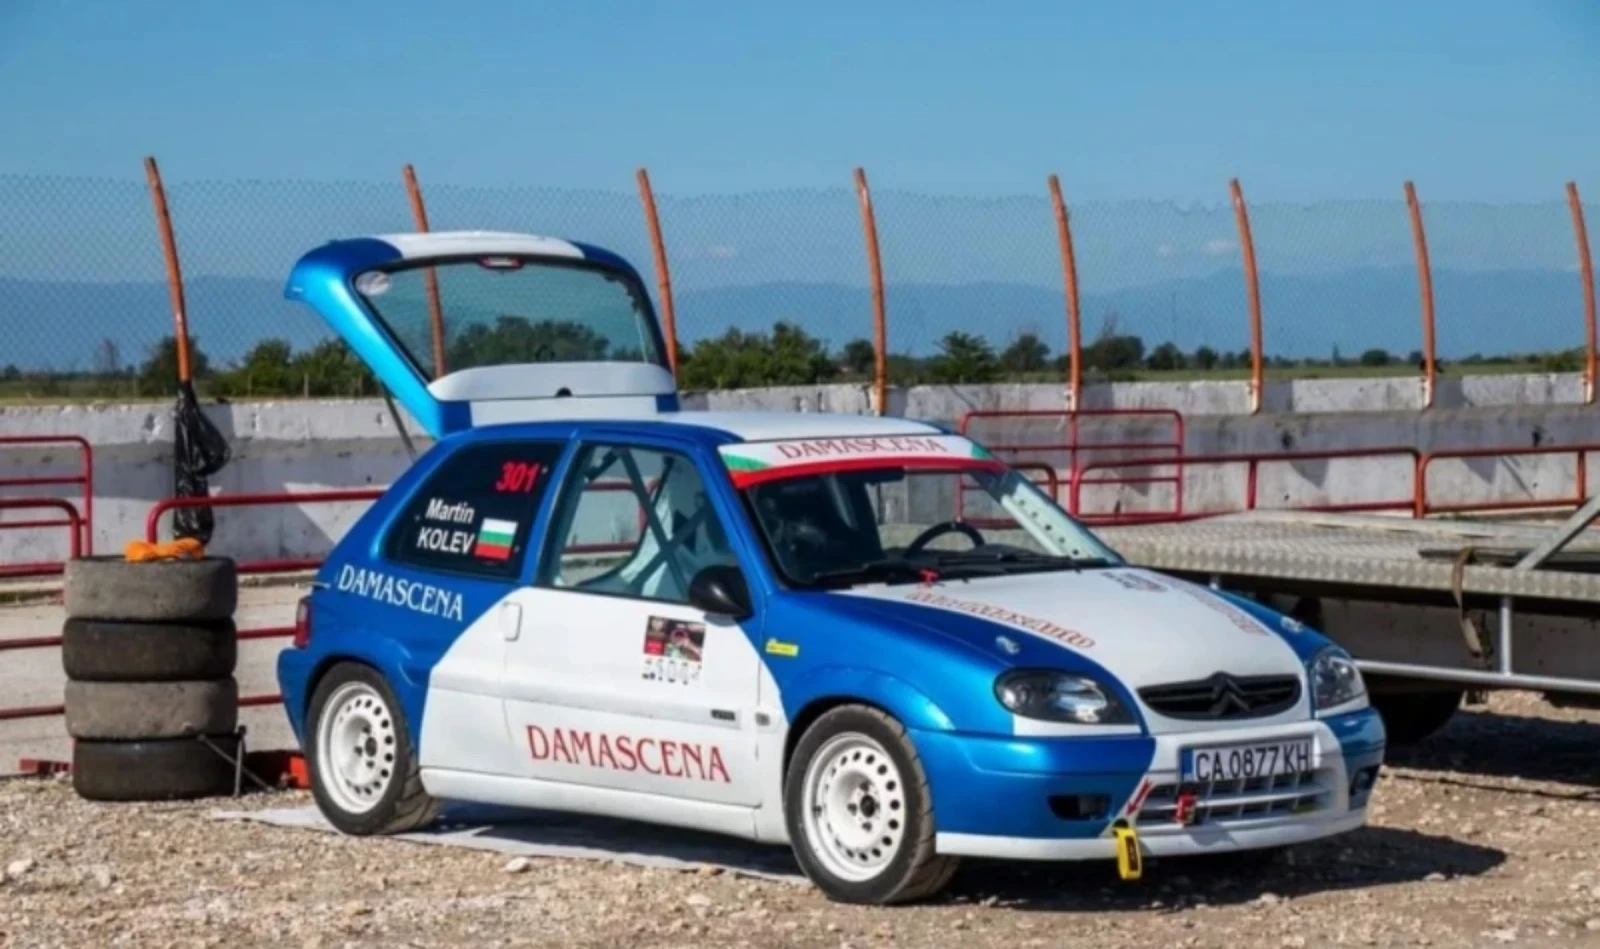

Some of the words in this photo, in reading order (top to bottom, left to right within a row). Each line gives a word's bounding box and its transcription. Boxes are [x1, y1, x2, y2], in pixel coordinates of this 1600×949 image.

[496, 461, 541, 493] 301
[425, 497, 475, 525] Martin
[416, 526, 474, 555] KOLEV
[338, 563, 463, 622] DAMASCENA
[526, 724, 732, 783] DAMASCENA
[1195, 750, 1224, 782] CA
[1229, 746, 1280, 778] 0877
[1283, 741, 1309, 773] KH
